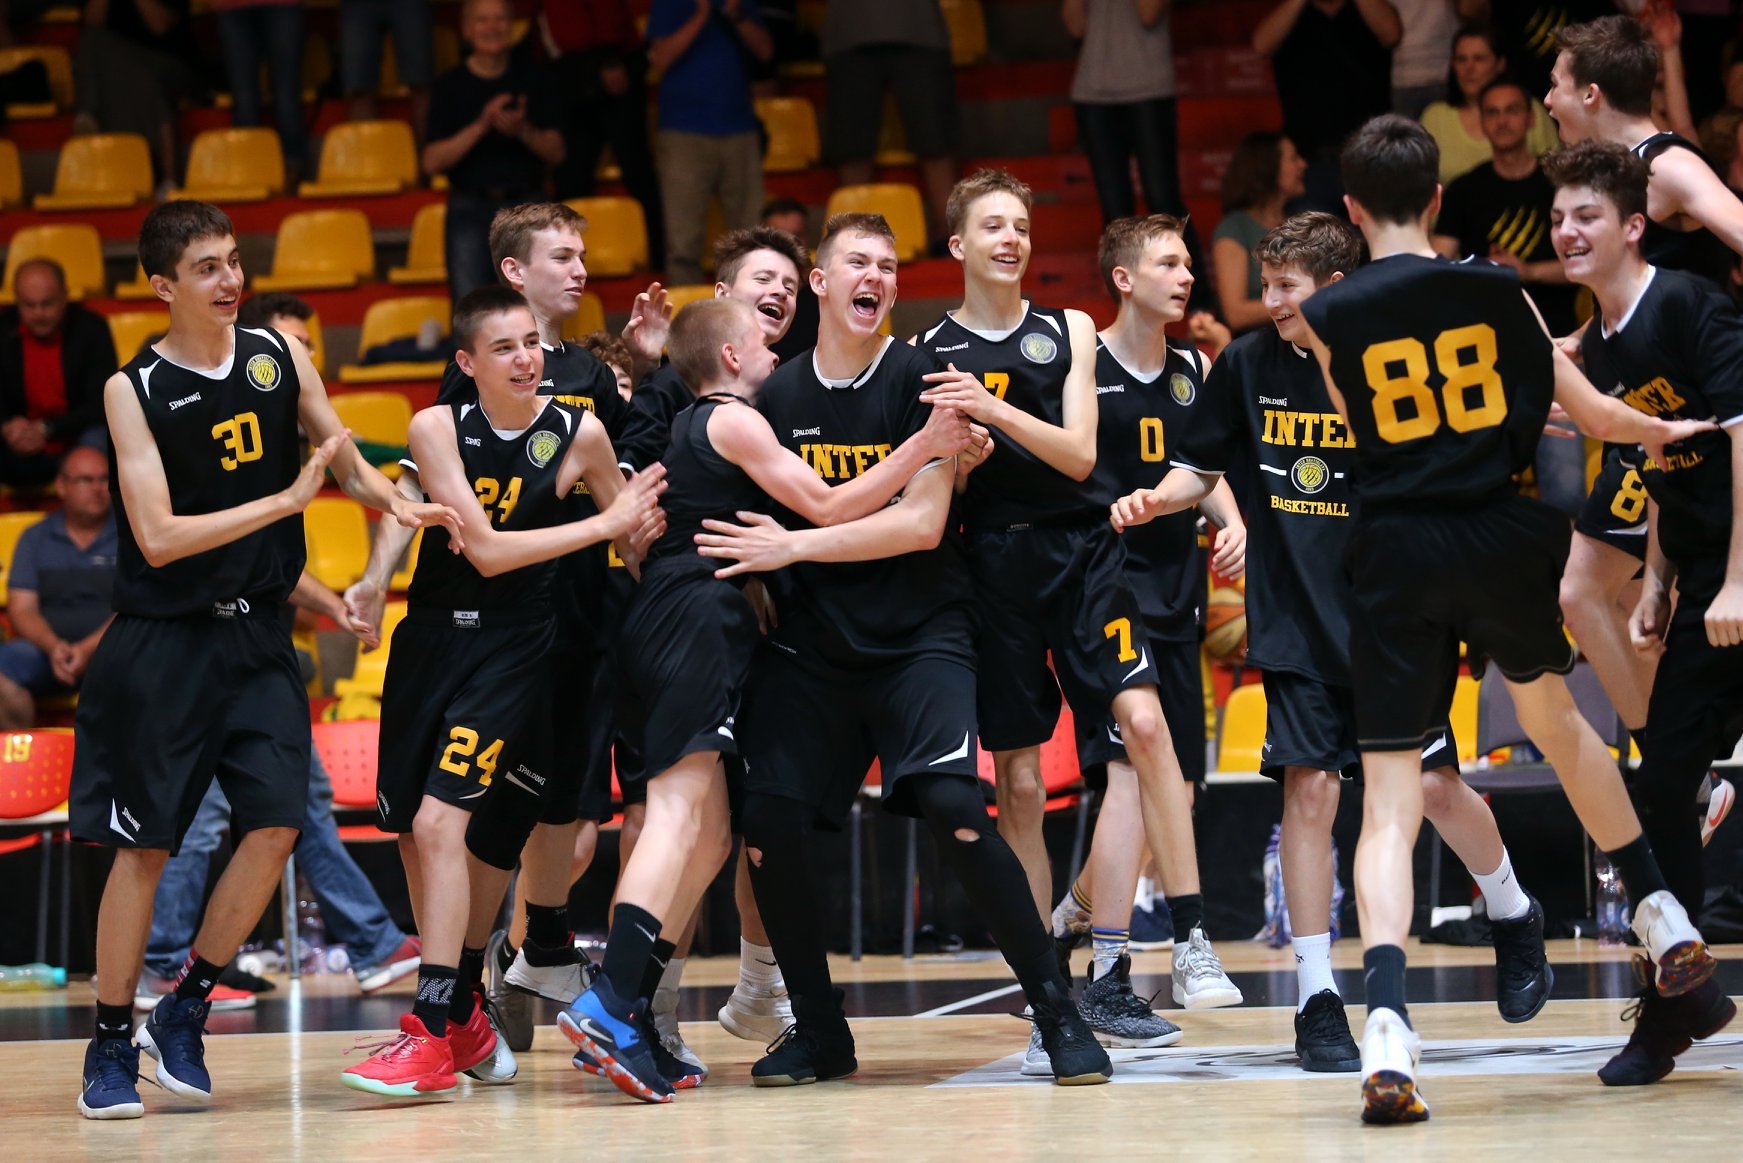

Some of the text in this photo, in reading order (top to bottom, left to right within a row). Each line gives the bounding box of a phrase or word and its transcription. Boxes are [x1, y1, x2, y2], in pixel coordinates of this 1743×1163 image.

[935, 341, 969, 352] SPALDING
[984, 372, 1010, 401] 7
[1362, 323, 1508, 444] 88
[168, 392, 202, 411] SPALDING
[1258, 395, 1288, 407] SPALDING
[211, 411, 264, 472] 30
[792, 426, 821, 438] SPALDING
[1139, 417, 1165, 463] 0
[1261, 409, 1357, 449] INTE
[474, 476, 523, 523] 24
[1269, 495, 1350, 517] BASKETBALL
[1103, 616, 1138, 663] 7
[438, 726, 505, 787] 24
[517, 764, 547, 786] SPALDING
